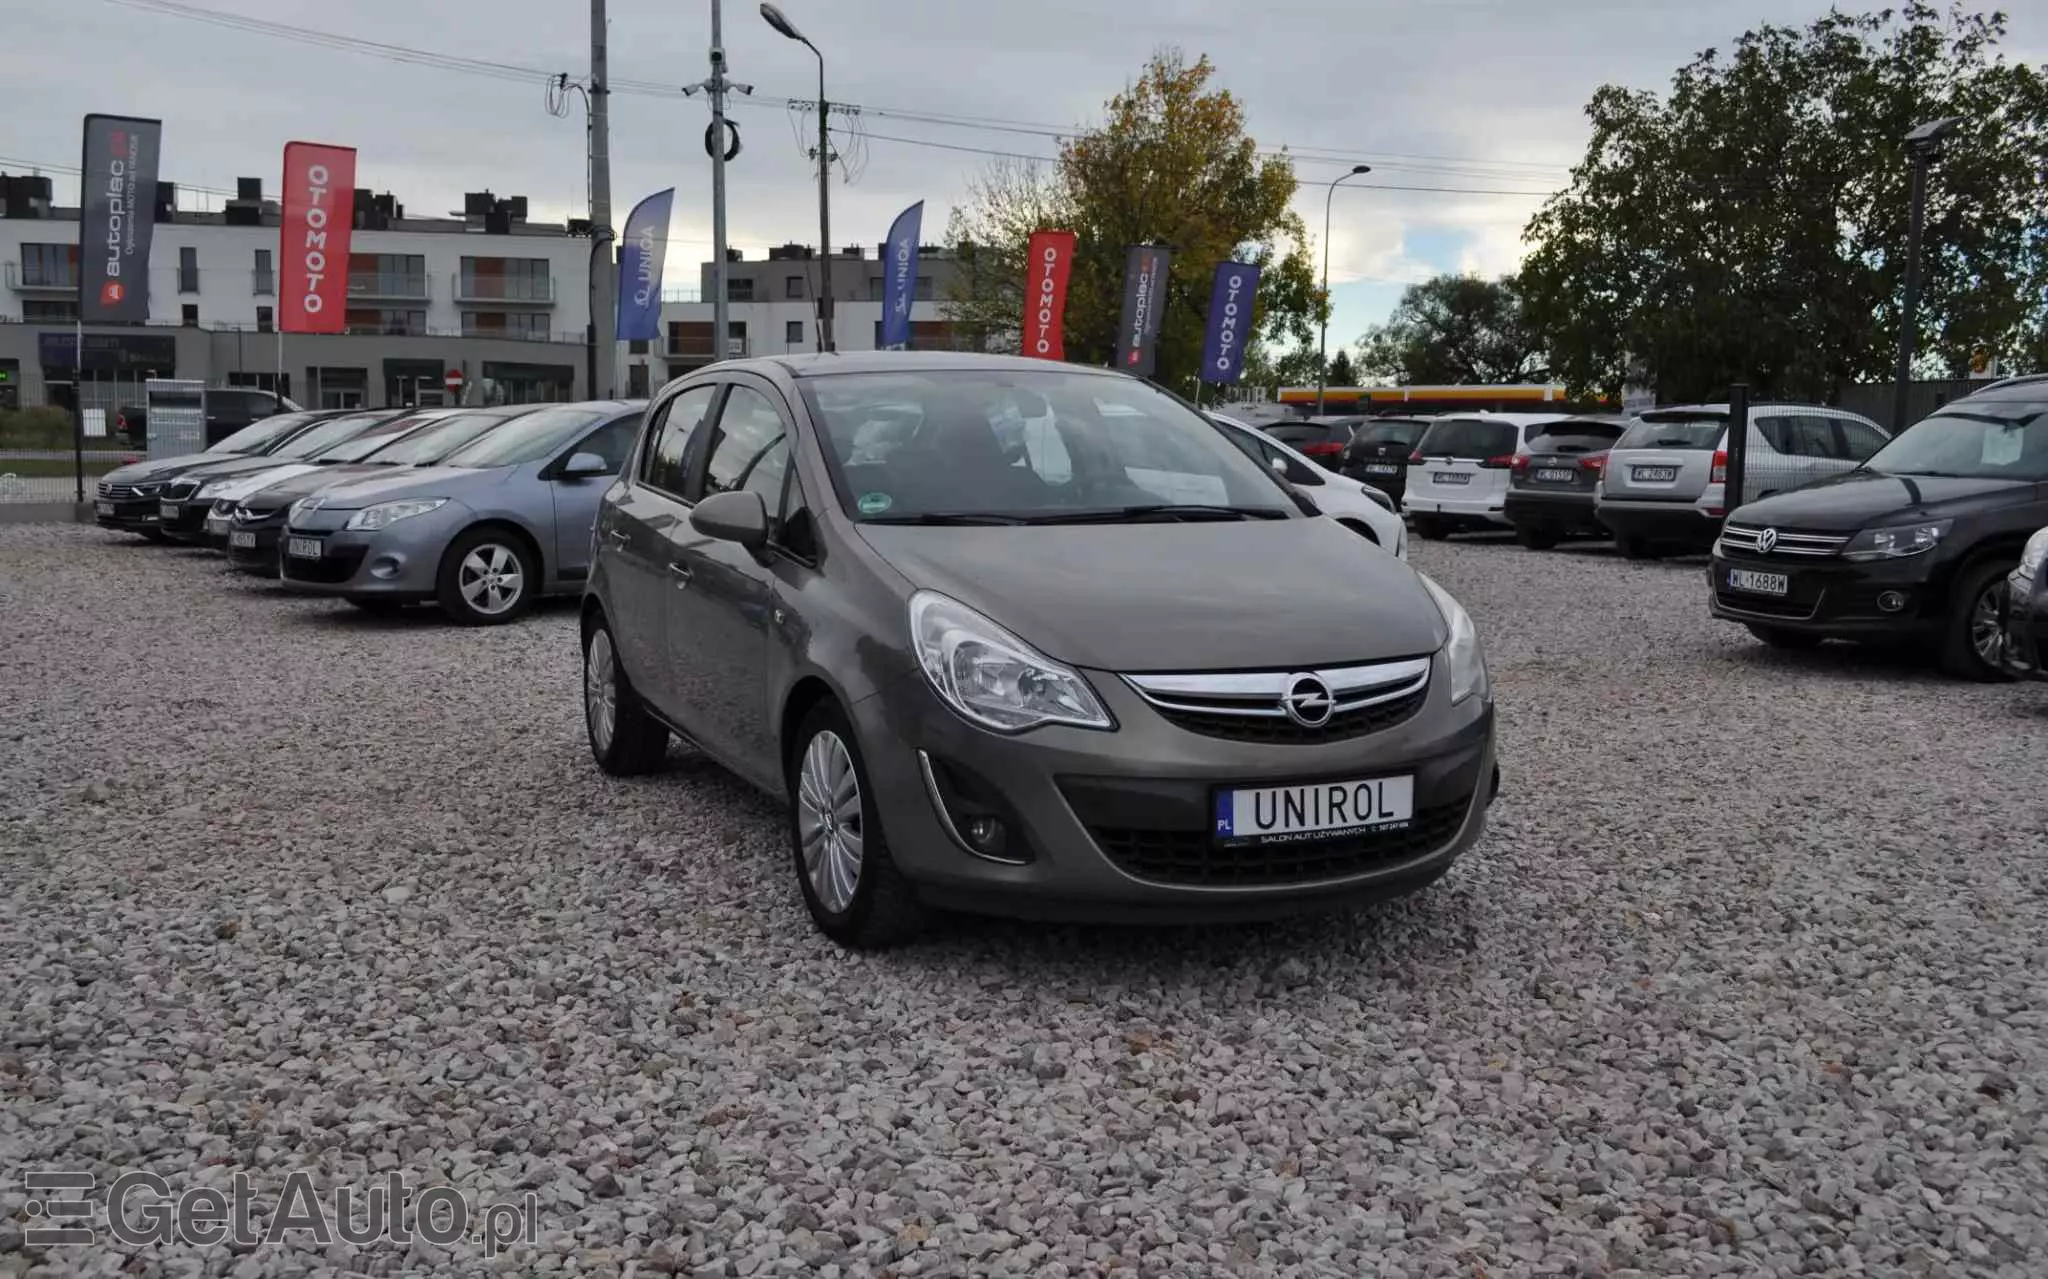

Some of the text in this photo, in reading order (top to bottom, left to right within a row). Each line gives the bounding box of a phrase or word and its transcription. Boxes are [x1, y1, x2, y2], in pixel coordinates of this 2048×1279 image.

[303, 165, 329, 313] OTOMOTO
[638, 225, 655, 281] UNIQA
[1037, 247, 1057, 353] OTOMOTO
[1217, 275, 1242, 370] OTOMOTO
[1217, 819, 1232, 831] PL
[1255, 781, 1394, 830] UNIROL
[1261, 833, 1294, 843] SALON
[1294, 831, 1314, 841] AUT
